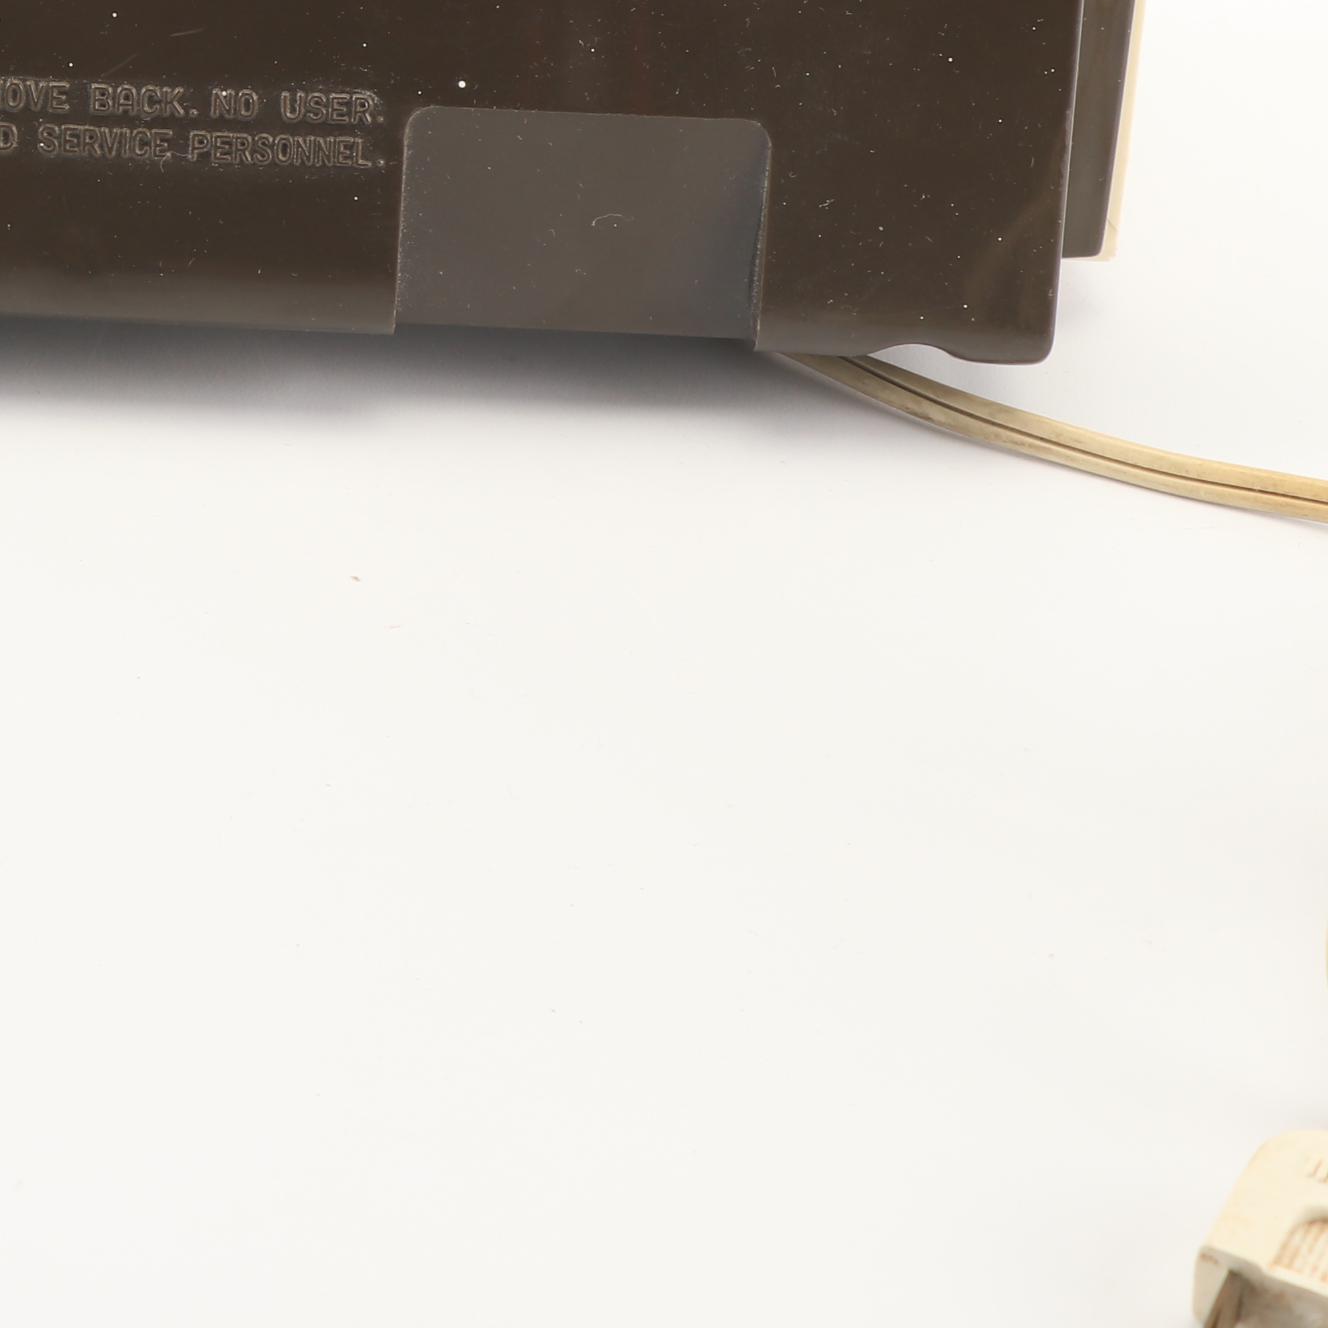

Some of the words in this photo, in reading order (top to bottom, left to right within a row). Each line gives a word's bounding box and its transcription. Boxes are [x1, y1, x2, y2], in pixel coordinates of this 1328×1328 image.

[90, 82, 199, 117] BACK.
[210, 87, 259, 120] NO
[37, 123, 173, 159] SERVICE
[188, 129, 386, 170] PERSONNEL.
